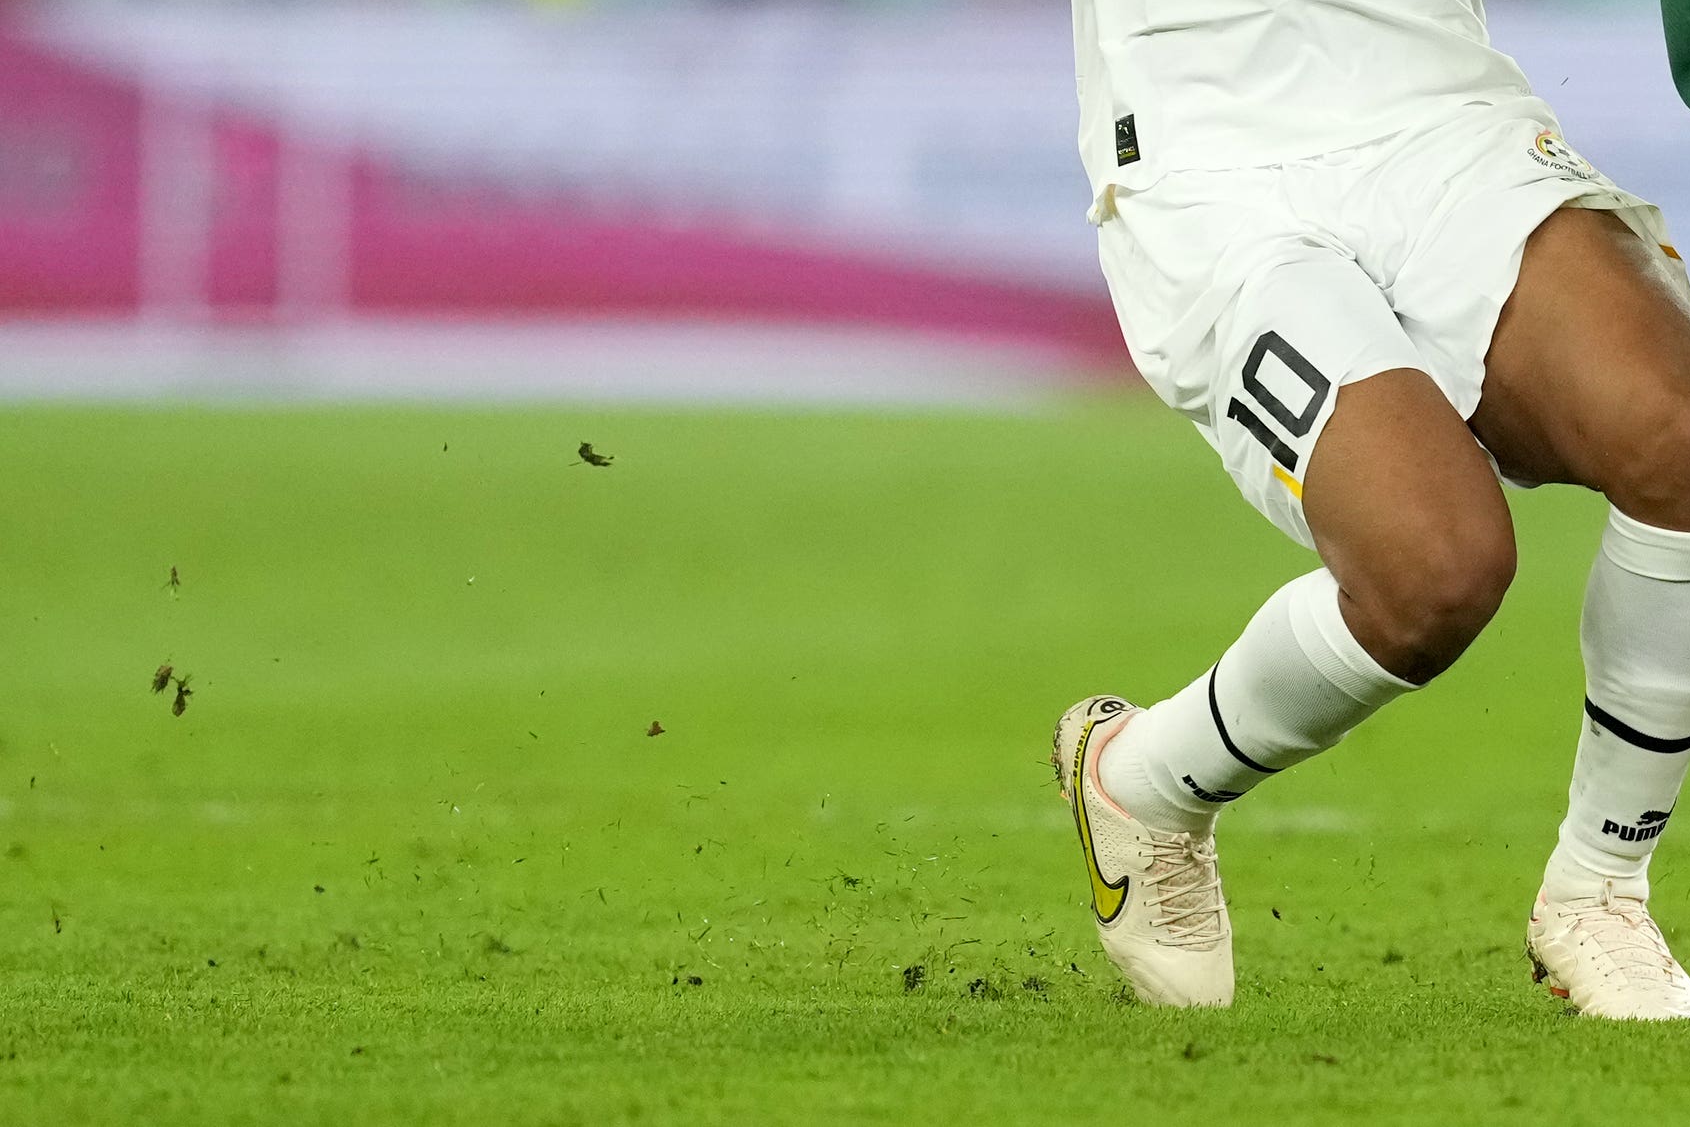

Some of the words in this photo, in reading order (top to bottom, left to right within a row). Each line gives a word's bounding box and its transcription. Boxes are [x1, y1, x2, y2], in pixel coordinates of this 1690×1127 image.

[1526, 147, 1548, 168] GHANA
[1549, 161, 1588, 180] FOOTBALL
[1226, 329, 1332, 474] 10
[1072, 725, 1090, 779] TIEMPO
